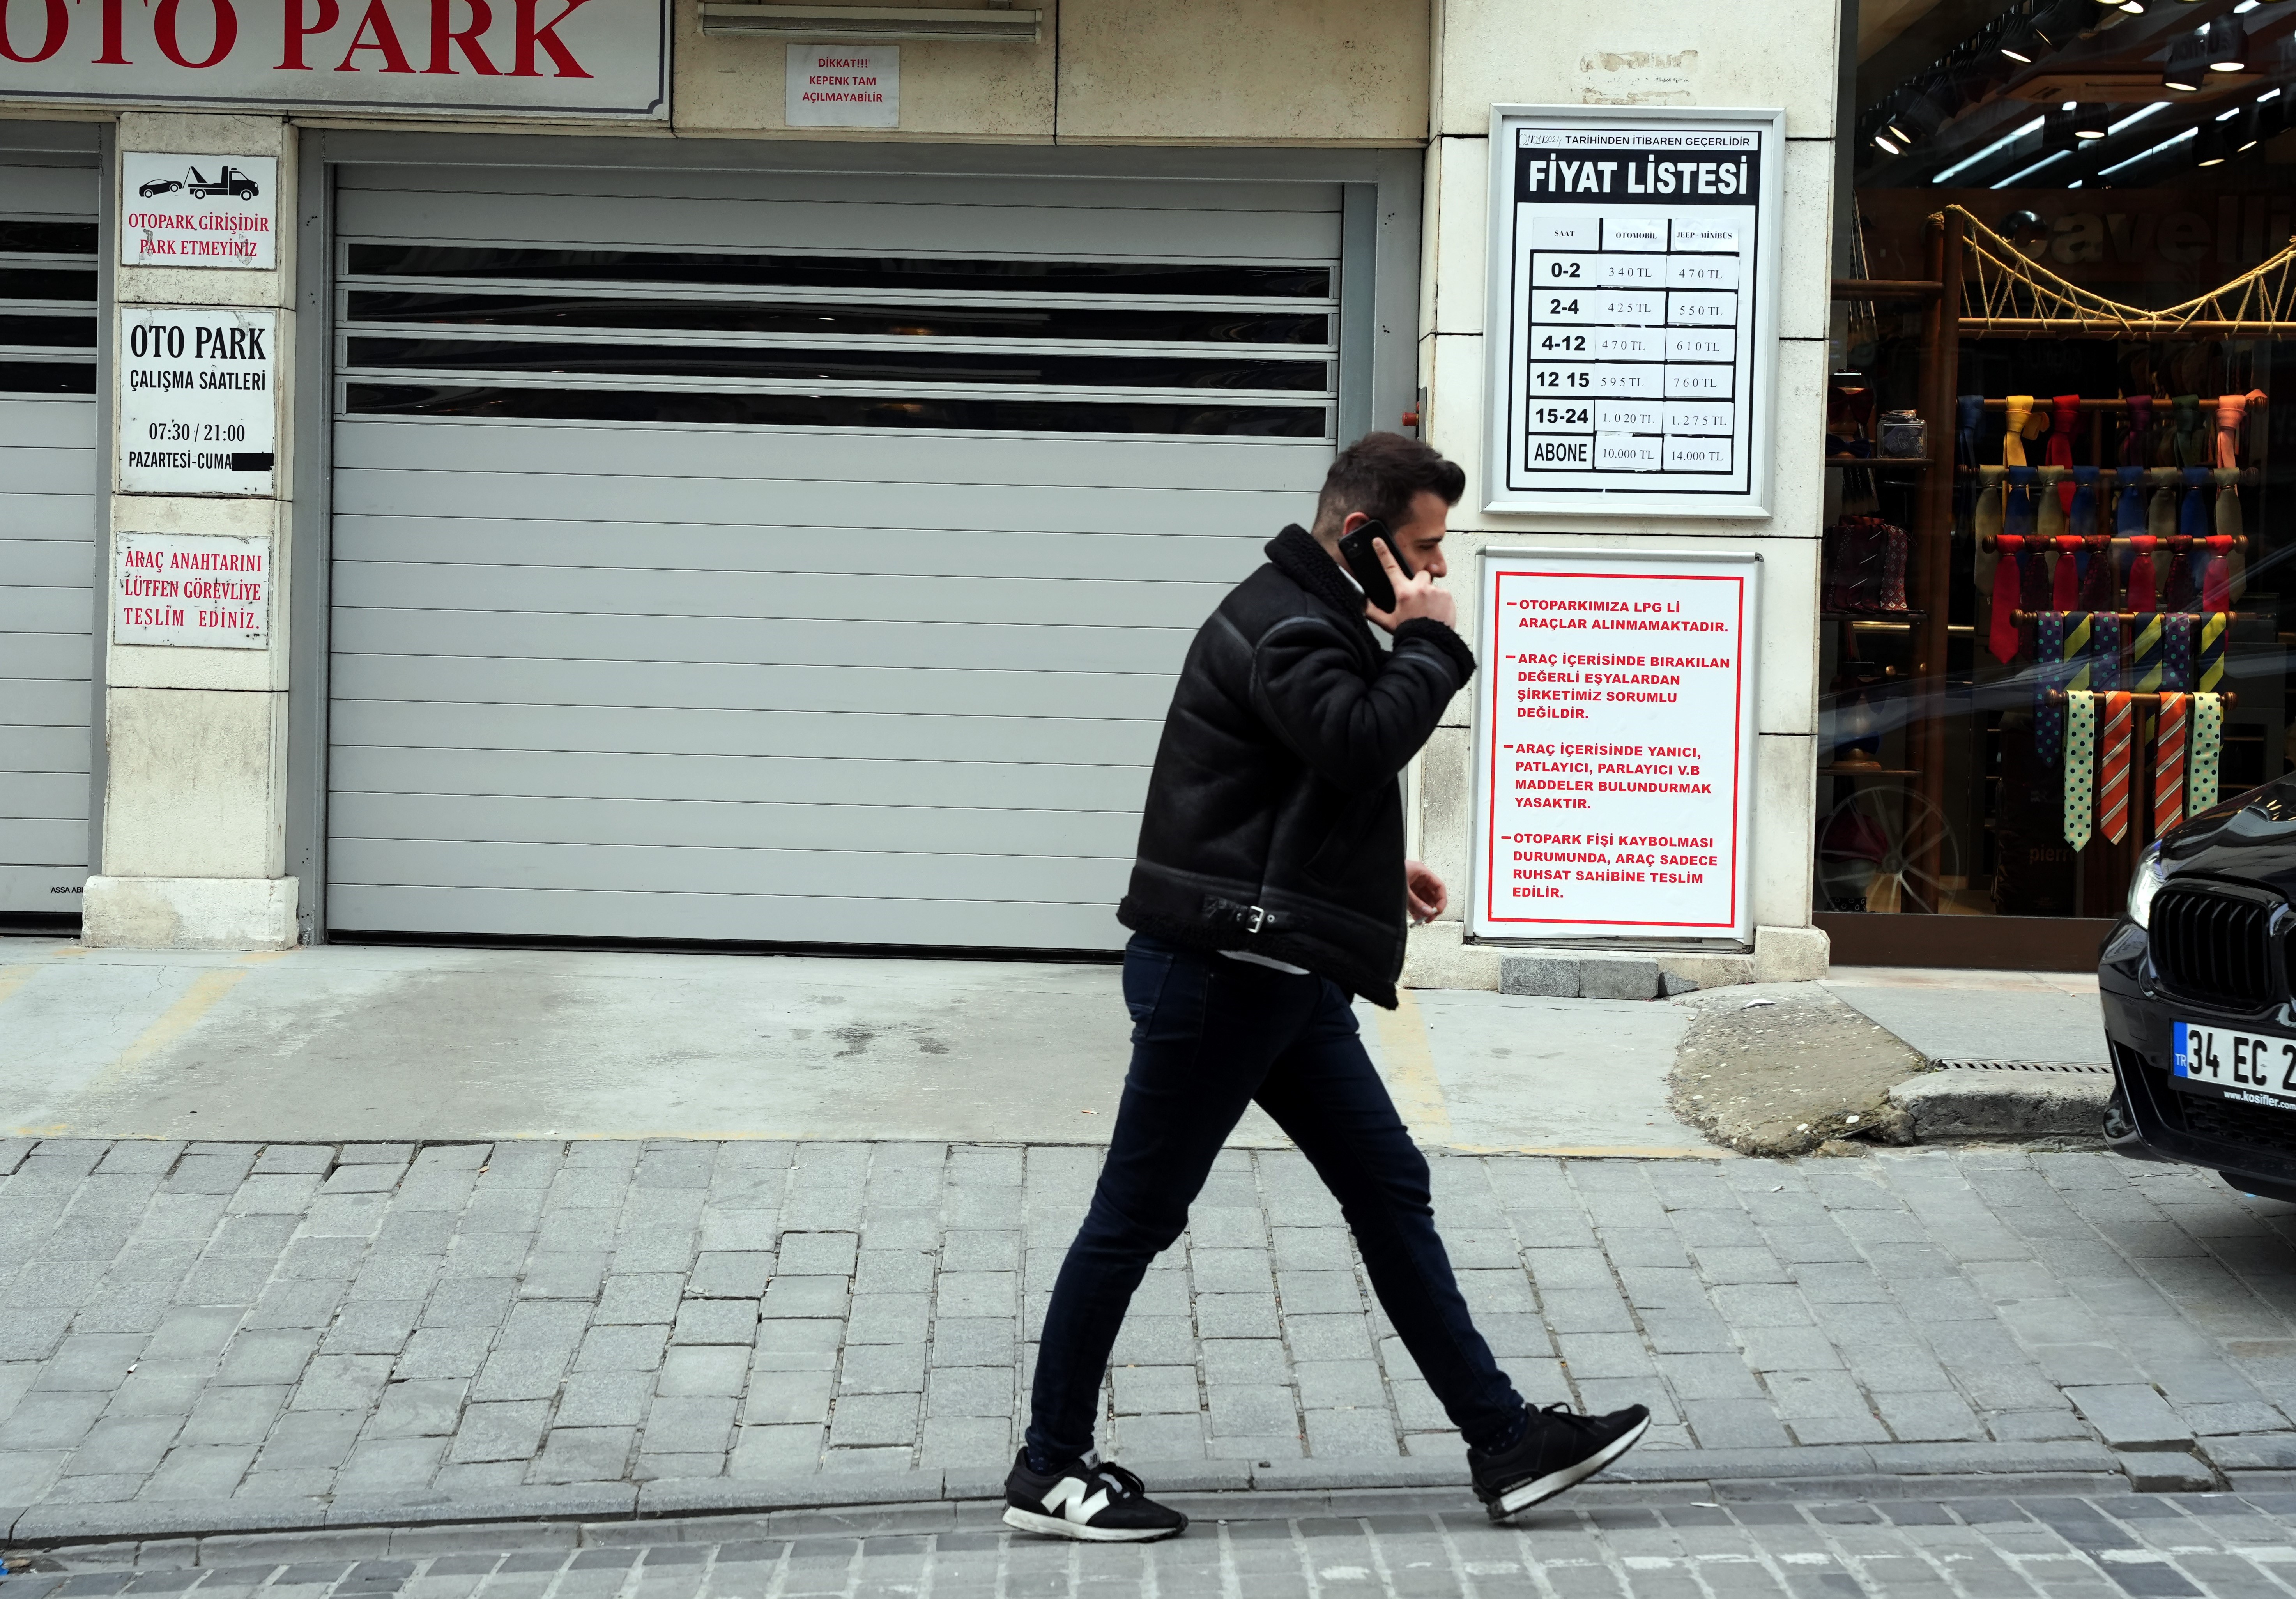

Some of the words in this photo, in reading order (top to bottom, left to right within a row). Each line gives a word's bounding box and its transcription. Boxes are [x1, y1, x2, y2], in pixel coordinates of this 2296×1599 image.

[0, 0, 237, 69] OTO
[273, 0, 594, 78] PARK
[819, 57, 868, 68] DİKKAT!!!
[810, 76, 849, 85] KEPENK
[852, 76, 876, 85] TAM
[802, 91, 883, 103] AÇILMAYABİLİR
[1565, 135, 1629, 145] TARİHİNDEN
[1633, 135, 1682, 145] İTİBAREN
[1685, 135, 1750, 147] GEÇERLİDİR
[1530, 153, 1617, 192] FİYAT
[1628, 154, 1747, 194] LİSTESİ
[129, 214, 195, 229] OTOPARK
[199, 213, 269, 234] GİRİŞİDİR
[1700, 231, 1732, 239] MİNİBÜS
[141, 239, 176, 254] PARK
[181, 239, 257, 256] ETMEYİNİZ
[1551, 263, 1580, 278] 0-2
[1637, 268, 1652, 278] TL
[1707, 269, 1723, 279] TL
[1550, 299, 1579, 315] 2-4
[1636, 303, 1651, 313] TL
[1707, 306, 1723, 316] TL
[131, 325, 184, 358] OTO
[195, 327, 266, 359] PARK
[1542, 336, 1585, 351] 4-12
[1630, 341, 1645, 351] TL
[1705, 342, 1720, 352] TL
[131, 370, 193, 392] ÇALIŞMA
[200, 370, 265, 390] SAATLERİ
[1629, 377, 1644, 387] TL
[1702, 378, 1717, 388] TL
[1535, 408, 1588, 424] 15-24
[1640, 414, 1654, 424] TL
[1712, 416, 1726, 426] TL
[150, 423, 189, 440] 07:30
[195, 424, 199, 442] /
[204, 425, 244, 441] 21:00
[1534, 443, 1587, 462] ABONE
[1603, 449, 1636, 459] 10.000
[1639, 450, 1654, 460] TL
[1672, 451, 1705, 461] 14.000
[1709, 452, 1723, 461] TL
[126, 551, 163, 572] ARAÇ
[170, 553, 261, 572] ANAHTARINI
[126, 575, 179, 597] LÜTFEN
[184, 578, 261, 600] GÖREVLİYE
[1519, 600, 1629, 612] OTOPARKIMIZA
[1634, 602, 1662, 612] LPG
[1667, 601, 1680, 613] Lİ
[124, 605, 184, 626] TESLİM
[199, 607, 259, 629] EDİNİZ.
[1519, 618, 1587, 630] ARAÇLAR
[1592, 619, 1728, 632] ALINMAMAKTADIR.
[1518, 654, 1557, 666] ARAÇ
[1563, 653, 1645, 667] İÇERİSİNDE
[1650, 657, 1730, 668] BIRAKILAN
[1518, 670, 1580, 683] DEĞERLİ
[1585, 673, 1680, 685] EŞYALARDAN
[1518, 688, 1601, 701] ŞİRKETİMİZ
[1606, 692, 1677, 703] SORUMLU
[1518, 706, 1588, 718] DEĞİLDİR.
[1516, 744, 1555, 756] ARAÇ
[1560, 743, 1643, 756] İÇERİSİNDE
[1648, 747, 1701, 759] YANICI,
[1516, 761, 1592, 774] PATLAYICI,
[1598, 763, 1672, 775] PARLAYICI
[1678, 765, 1700, 775] V.B
[1516, 780, 1594, 791] MADDELER
[1599, 782, 1711, 794] BULUNDURMAK
[1515, 798, 1590, 808] YASAKTIR.
[1514, 833, 1581, 844] OTOPARK
[1587, 833, 1613, 847] FİŞİ
[1619, 836, 1713, 848] KAYBOLMASI
[1514, 851, 1610, 864] DURUMUNDA,
[1616, 854, 1655, 866] ARAÇ
[1660, 855, 1717, 866] SADECE
[1513, 869, 1571, 880] RUHSAT
[1576, 869, 1645, 882] SAHİBİNE
[1650, 872, 1703, 883] TESLİM
[1513, 886, 1563, 898] EDİLİR.
[2175, 1053, 2186, 1067] TR
[2189, 1030, 2220, 1077] 34
[2234, 1036, 2267, 1086] EC
